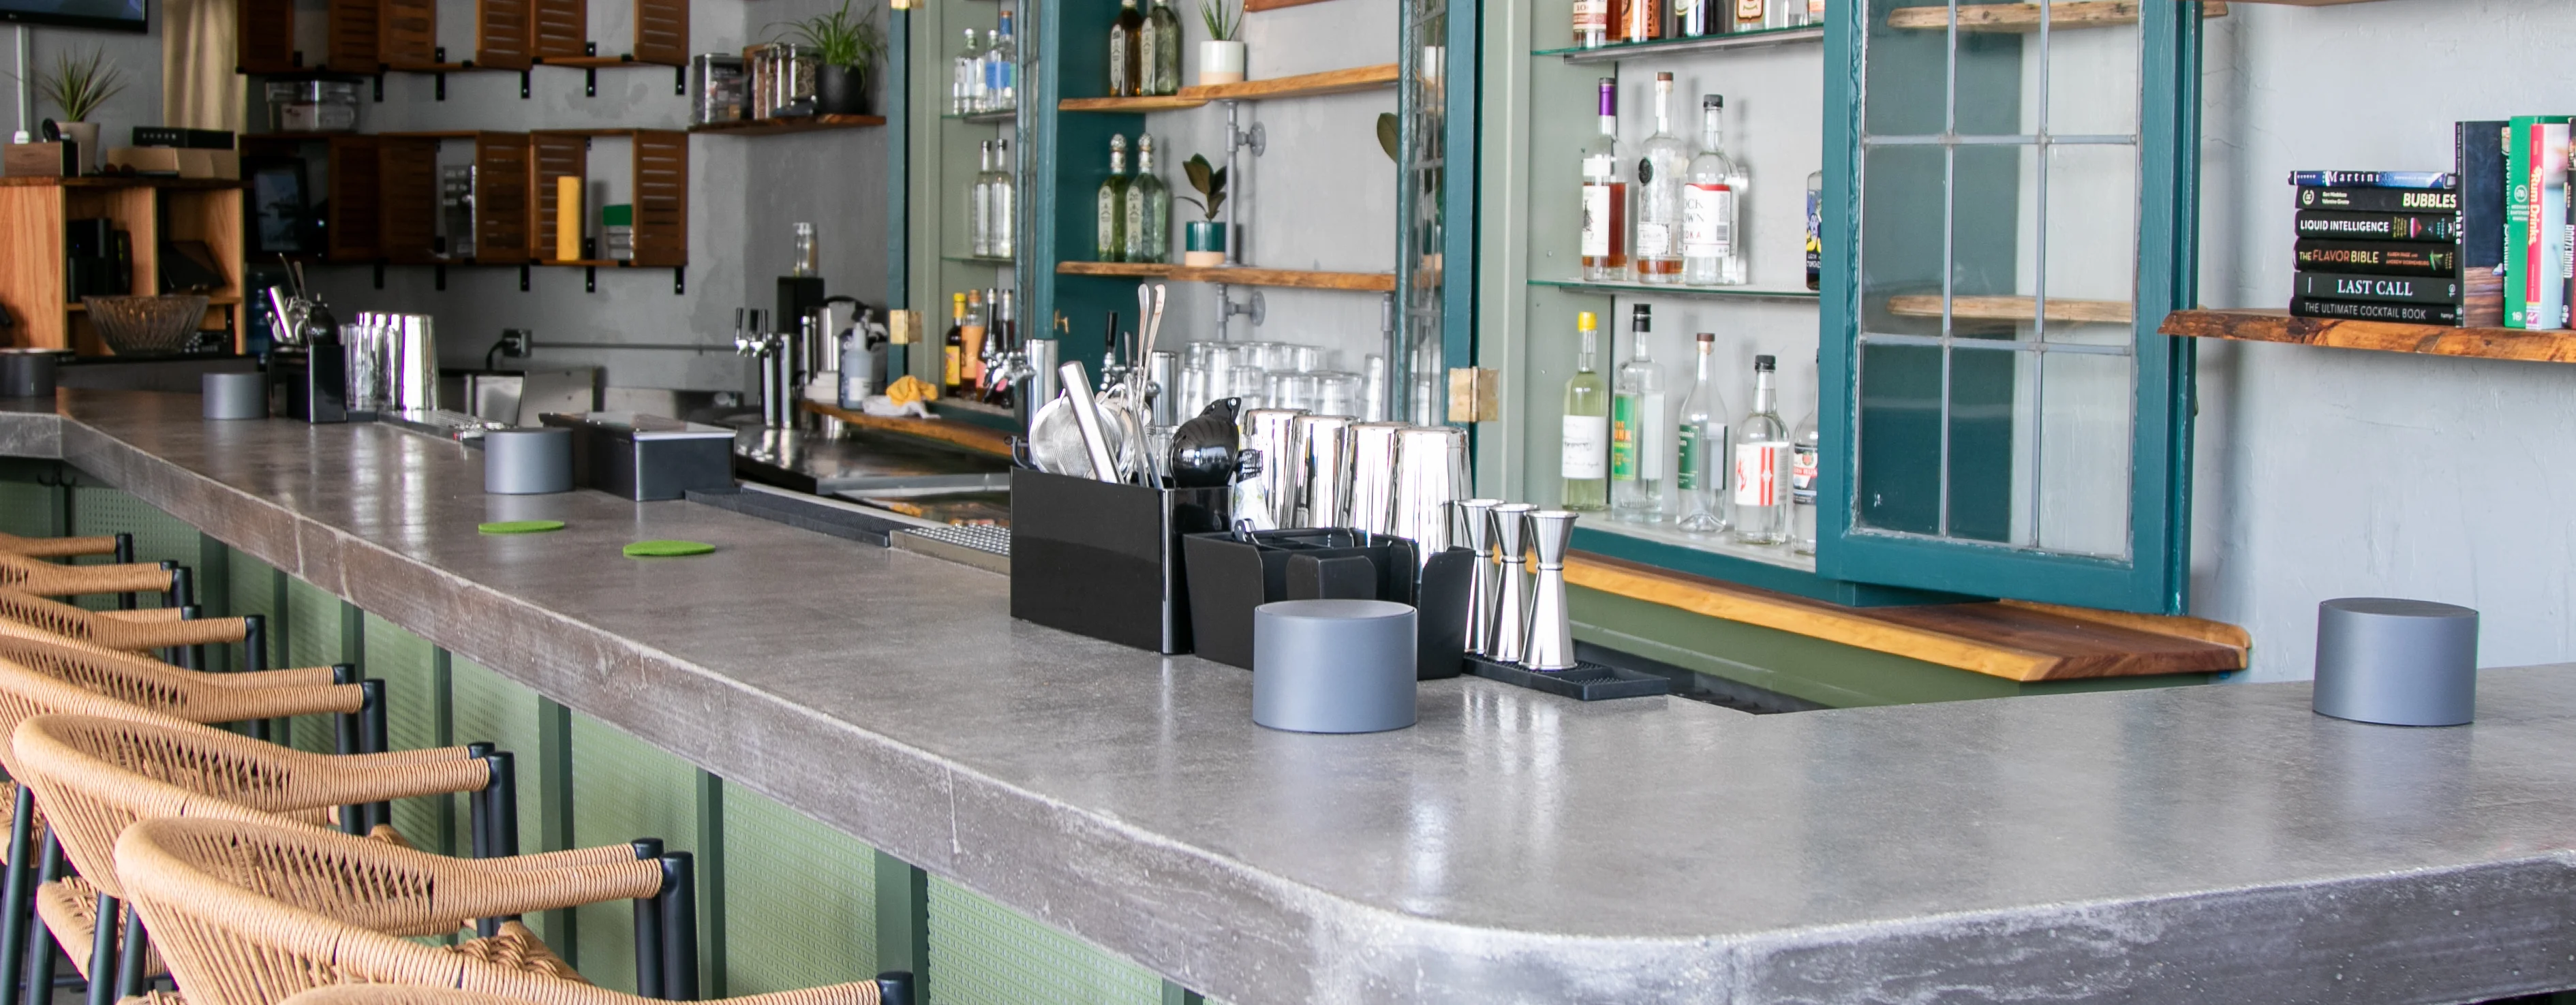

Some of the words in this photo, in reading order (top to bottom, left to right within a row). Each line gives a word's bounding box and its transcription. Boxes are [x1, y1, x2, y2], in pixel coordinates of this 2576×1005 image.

[2327, 170, 2380, 183] Martini
[2530, 171, 2541, 202] Rum
[2403, 192, 2456, 208] BUBBLES
[2300, 219, 2329, 230] LIQUID
[2330, 220, 2389, 232] INTELLIGENCE
[2455, 211, 2463, 245] shake
[2529, 204, 2540, 245] Drinks
[2299, 251, 2312, 261] THE
[2313, 249, 2350, 262] FLAVOR
[2351, 251, 2379, 264] BIBLE
[2337, 279, 2372, 294] LAST
[2376, 281, 2413, 296] CALL
[2305, 303, 2320, 313] THE
[2321, 304, 2358, 315] ULTIMATE
[2360, 305, 2399, 318] COCKTAIL
[2402, 308, 2426, 320] BOOK
